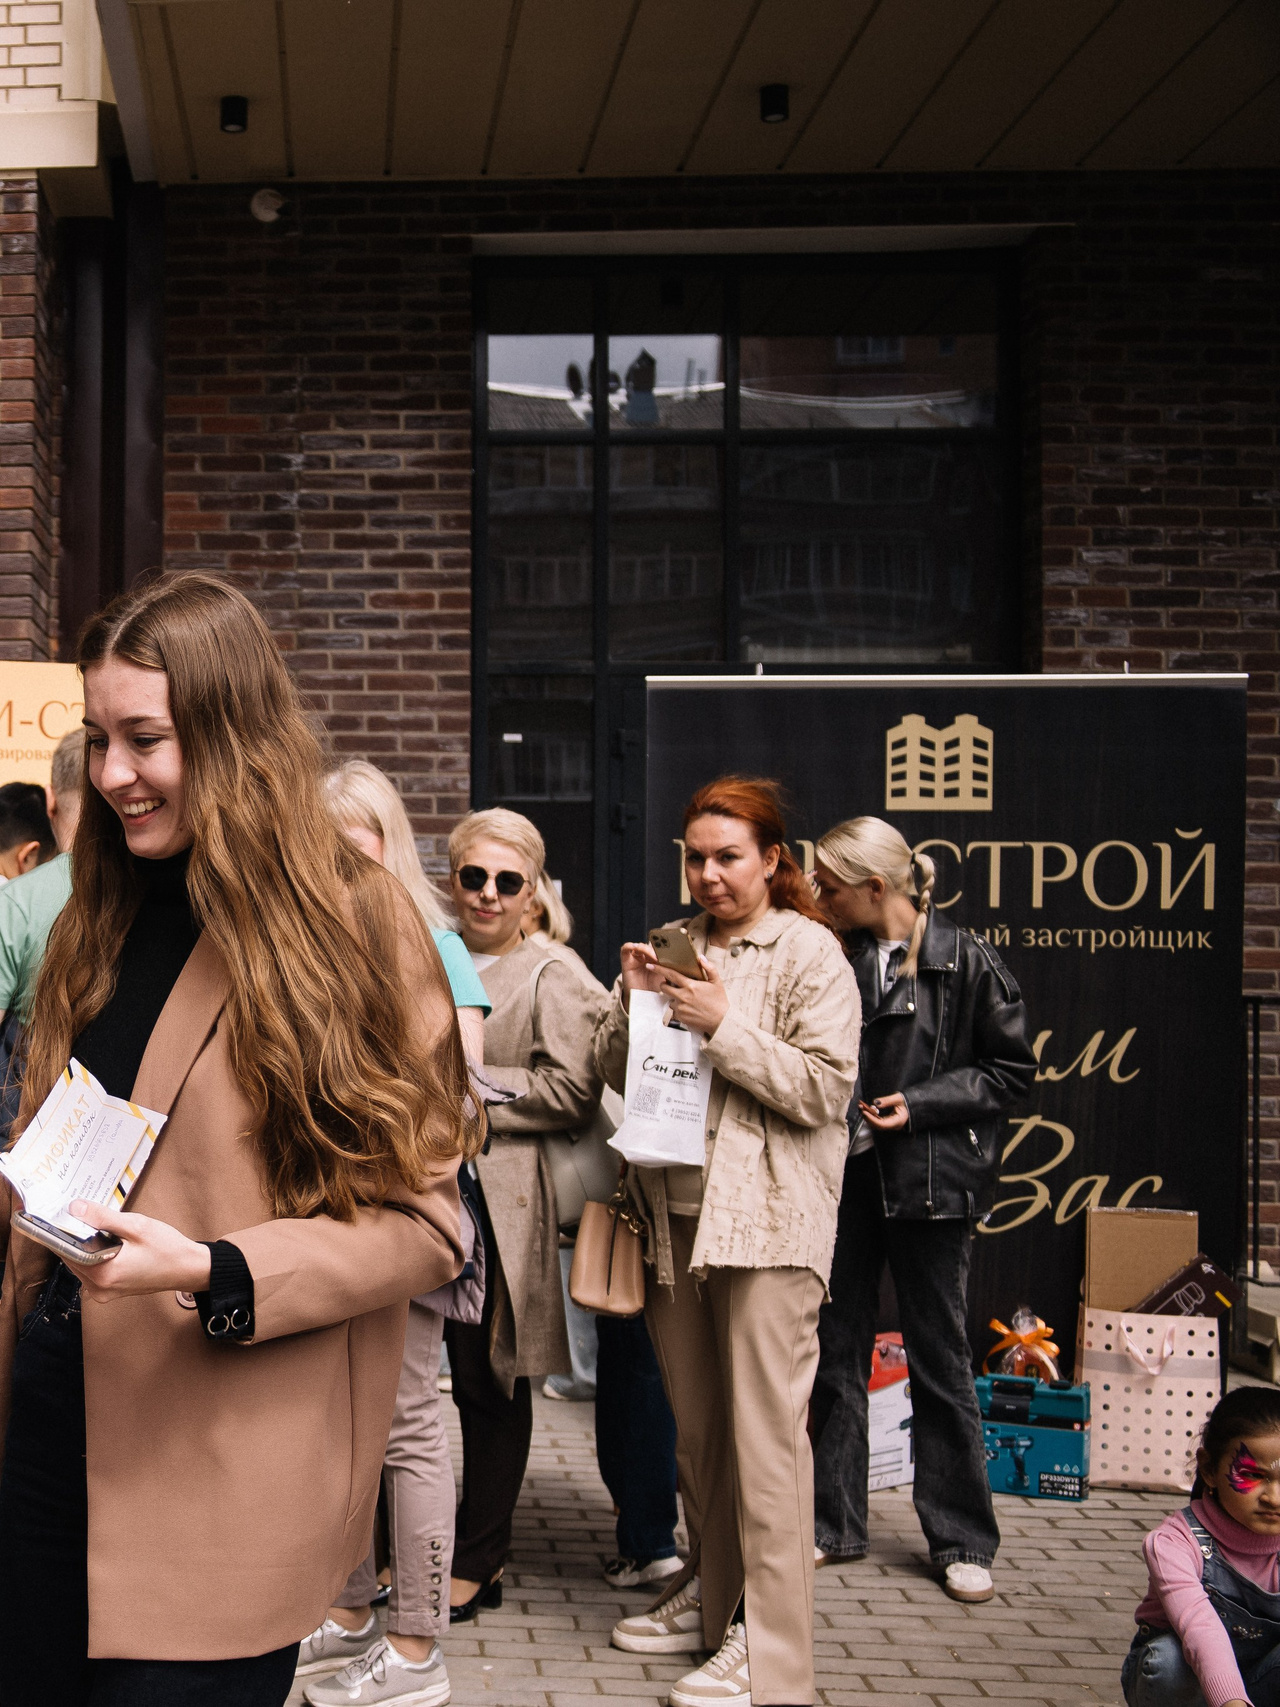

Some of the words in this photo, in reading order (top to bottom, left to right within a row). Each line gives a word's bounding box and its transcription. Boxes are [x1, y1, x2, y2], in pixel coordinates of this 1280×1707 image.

[1022, 925, 1213, 954] застройщик
[32, 1094, 90, 1183] ТИФИКАТ
[57, 1161, 70, 1181] на
[69, 1110, 97, 1160] кэшбэк
